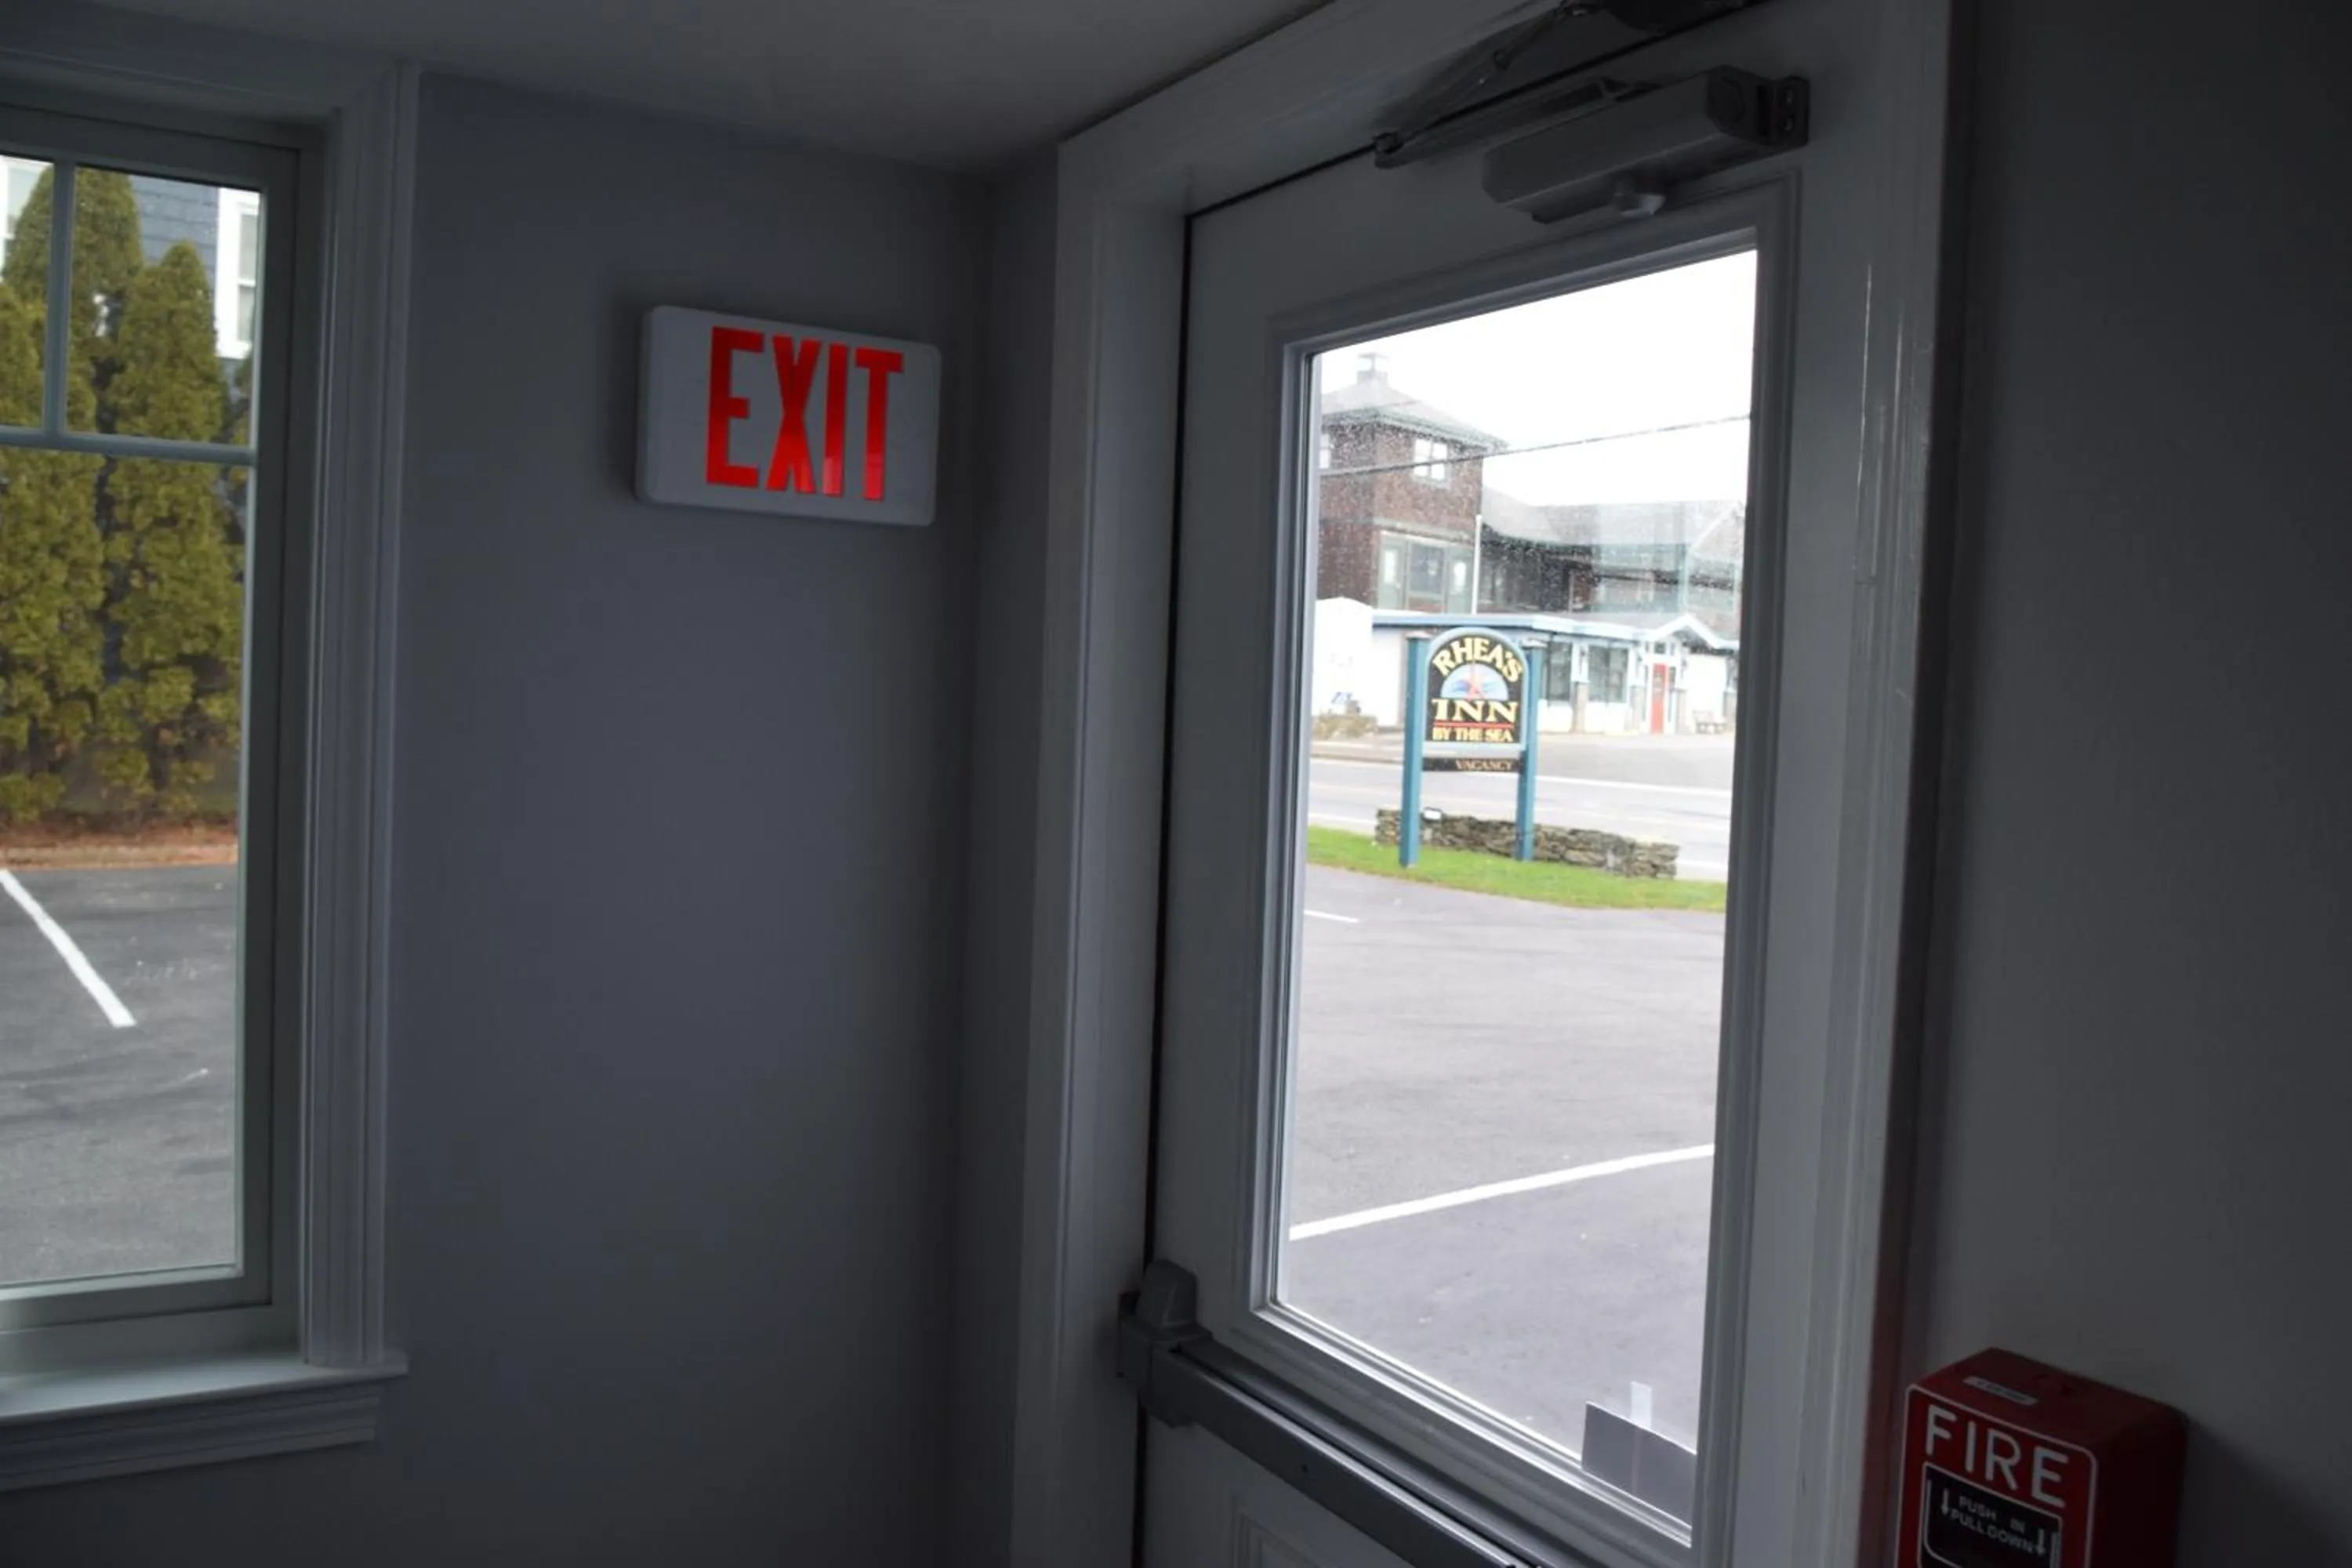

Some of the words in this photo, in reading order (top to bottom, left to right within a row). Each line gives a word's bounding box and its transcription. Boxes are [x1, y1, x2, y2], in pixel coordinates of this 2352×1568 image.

[706, 325, 904, 503] EXIT
[1432, 637, 1523, 683] RHEA'S
[1431, 698, 1519, 724] INN
[1432, 727, 1451, 741] BY
[1454, 727, 1483, 742] THE
[1485, 728, 1514, 742] SEA
[1454, 759, 1513, 771] VACANCY
[1926, 1403, 2069, 1508] FIRE
[1949, 1508, 1986, 1534] PULL
[1986, 1524, 2036, 1554] DOWN
[1958, 1494, 1997, 1521] PUSH
[2009, 1517, 2026, 1534] IN
